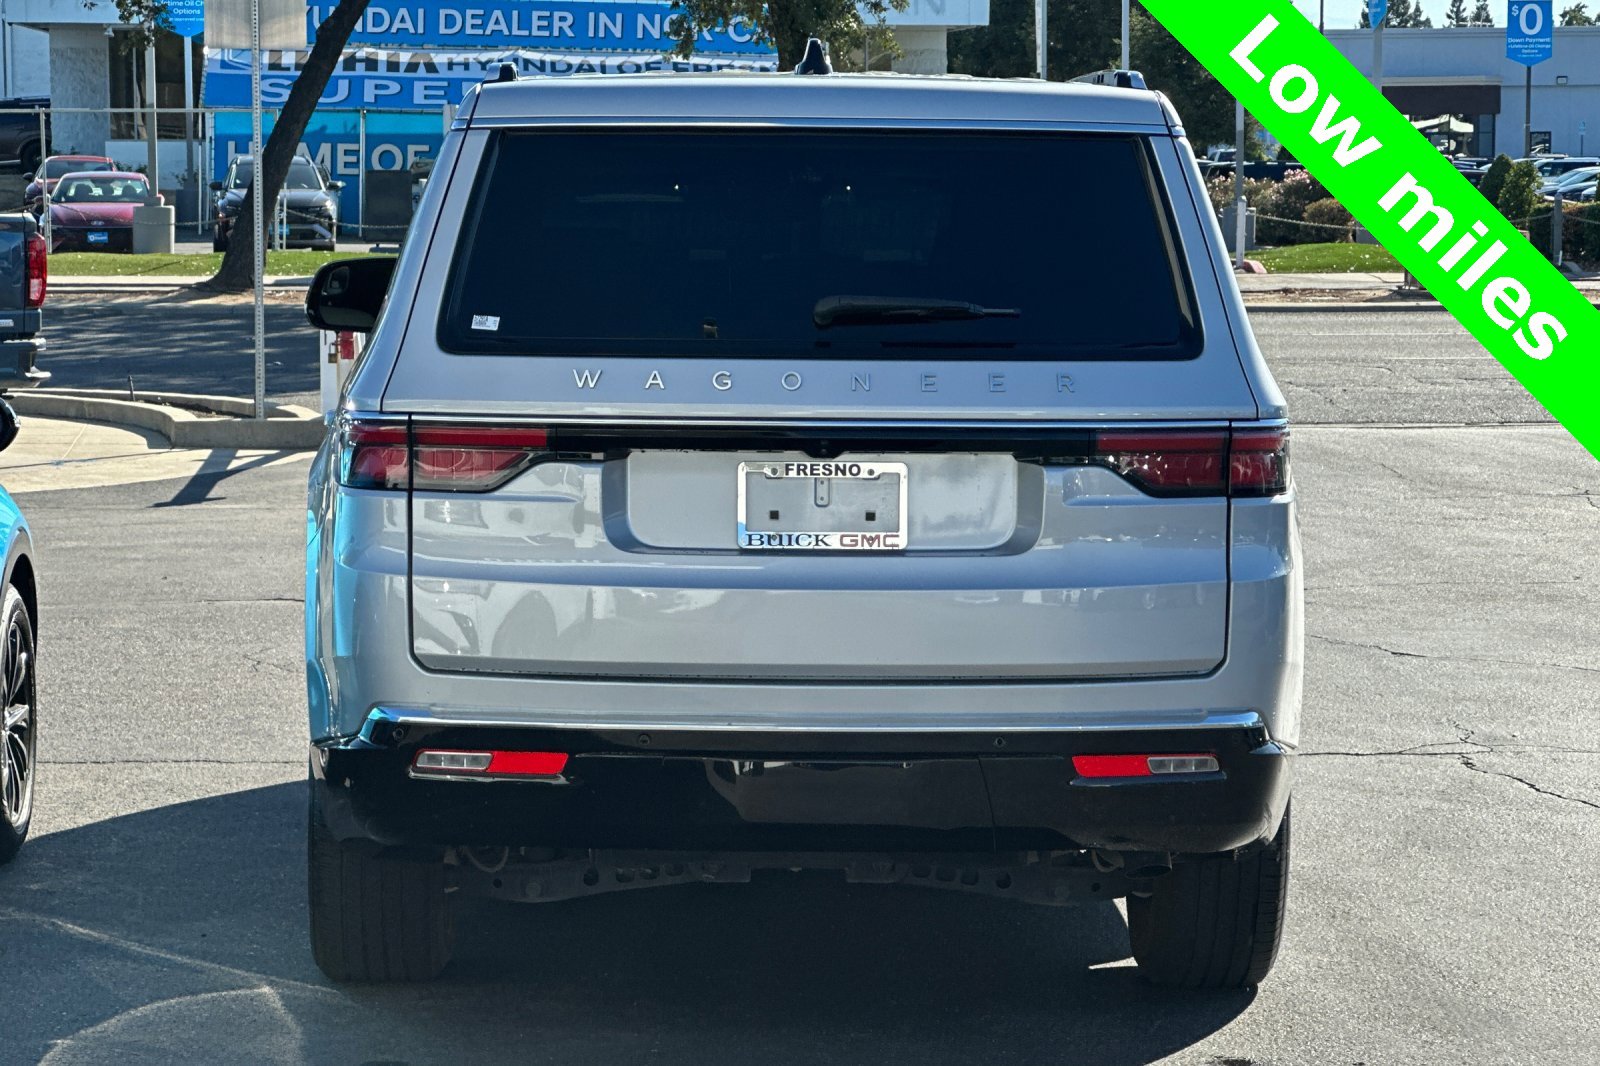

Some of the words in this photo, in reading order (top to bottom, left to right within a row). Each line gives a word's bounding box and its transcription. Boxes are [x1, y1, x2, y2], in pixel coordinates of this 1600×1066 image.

[173, 7, 200, 15] Options
[306, 6, 424, 34] UDAI
[439, 8, 575, 37] DEALER
[588, 11, 623, 38] IN
[1511, 4, 1543, 35] $0
[268, 50, 439, 74] LIHIA
[616, 61, 662, 73] OF
[227, 140, 343, 175] HME
[572, 368, 1076, 393] WAGONEER
[784, 463, 862, 477] FRESNO
[746, 533, 832, 547] BUICK
[839, 534, 900, 548] GMC
